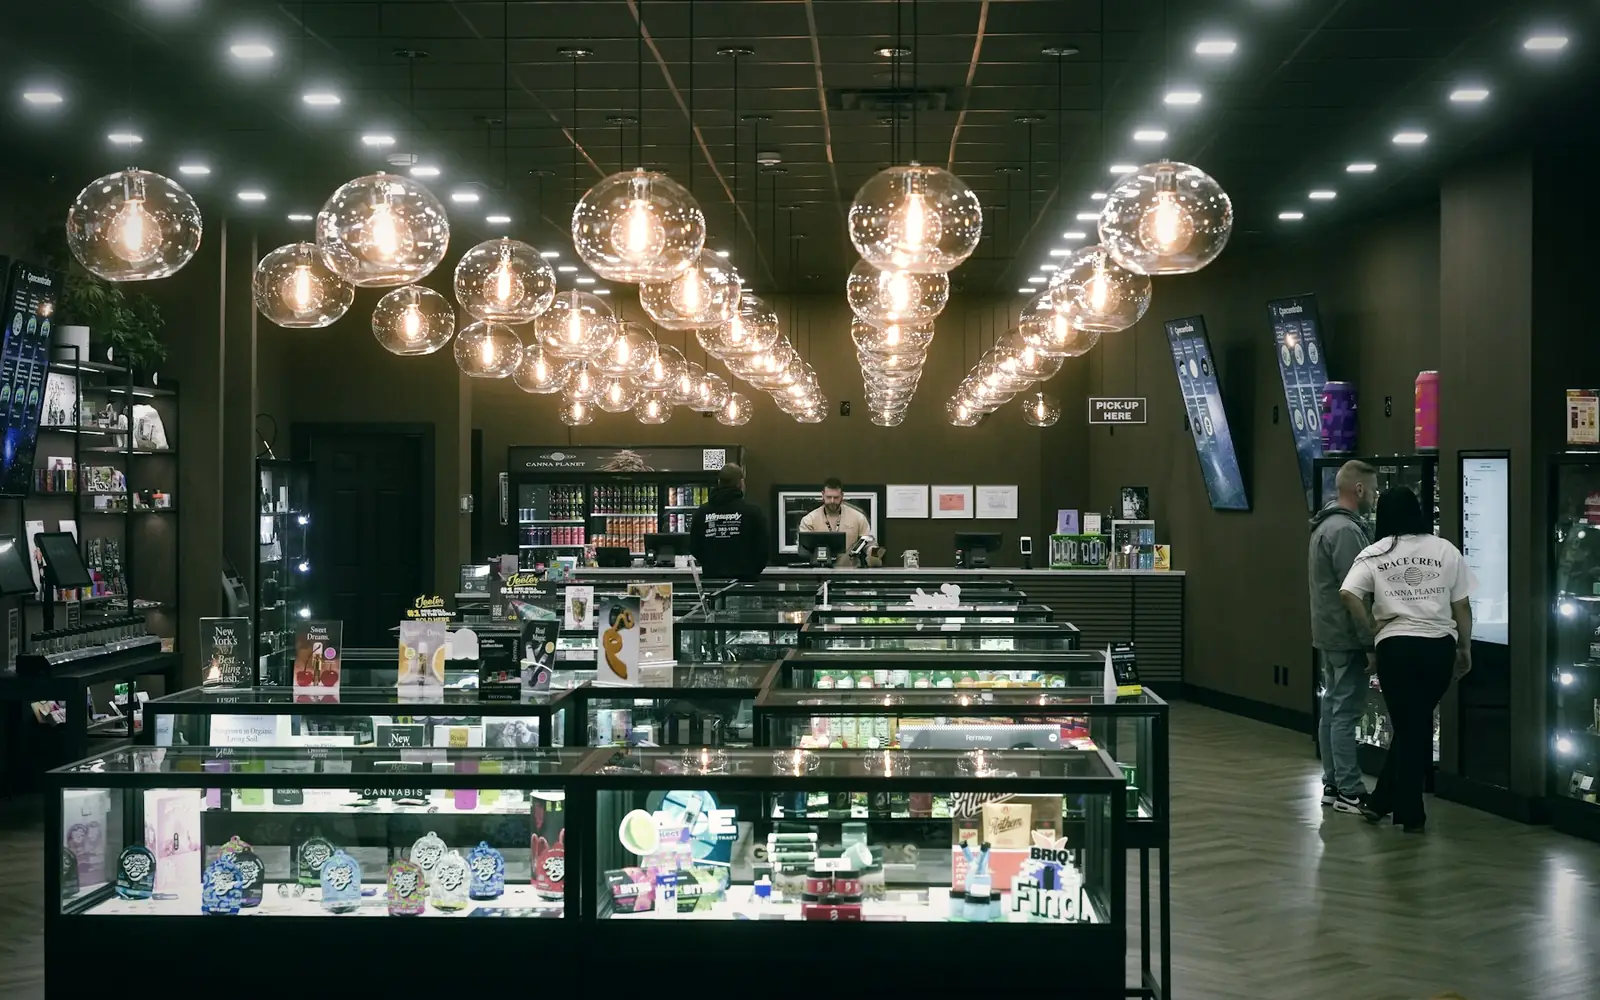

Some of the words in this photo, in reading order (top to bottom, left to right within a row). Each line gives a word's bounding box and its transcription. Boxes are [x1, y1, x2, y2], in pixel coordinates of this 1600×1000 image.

[1096, 401, 1139, 410] PICK-UP
[1103, 412, 1132, 420] HERE
[705, 512, 742, 521] Winsupply
[1377, 557, 1410, 572] SPACE
[1411, 557, 1442, 568] CREW
[506, 573, 539, 587] Jeeter
[1384, 589, 1413, 597] CANNA
[1414, 586, 1446, 596] PLANET
[215, 626, 235, 636] New
[212, 636, 238, 645] York's
[391, 733, 411, 744] New
[965, 733, 993, 742] Fernway
[364, 788, 423, 796] CANNABIS
[988, 815, 1023, 835] Anthem
